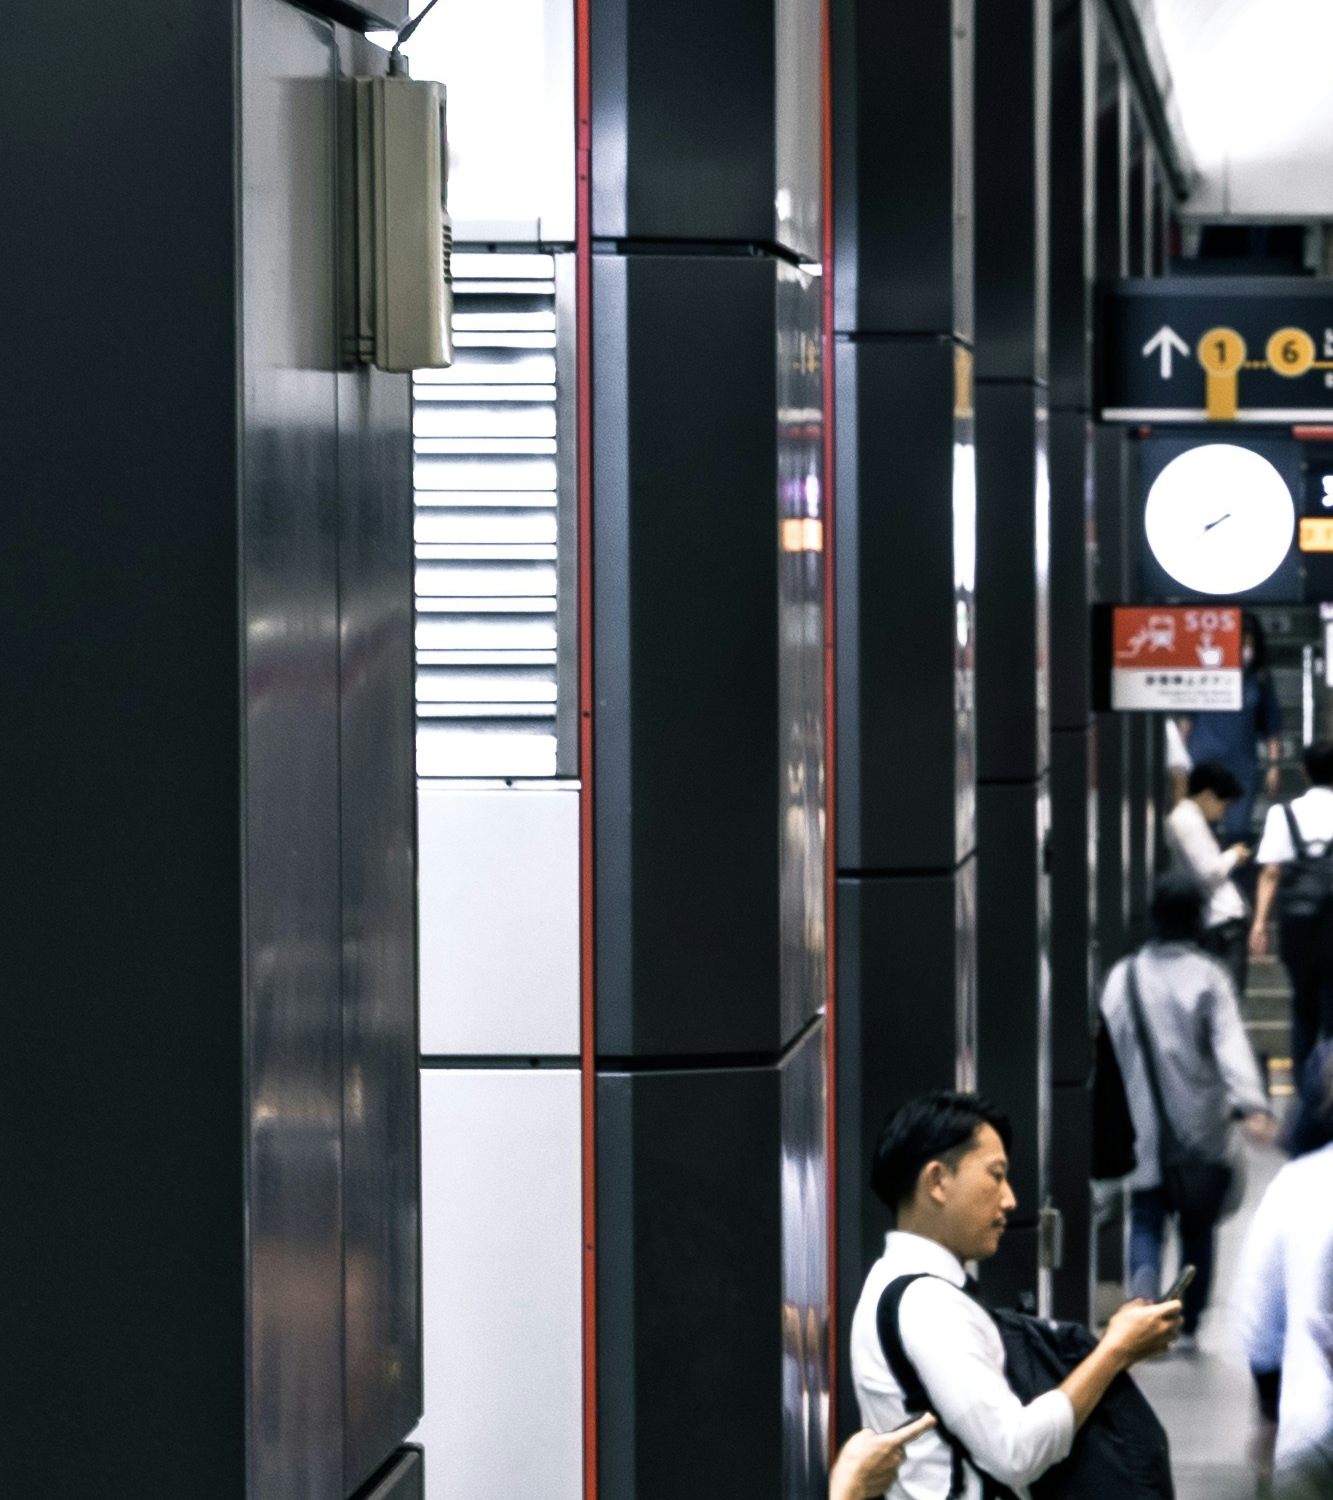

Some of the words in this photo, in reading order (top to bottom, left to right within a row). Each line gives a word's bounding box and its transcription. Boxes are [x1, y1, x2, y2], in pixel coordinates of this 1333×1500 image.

[1214, 340, 1227, 363] 1
[1281, 340, 1299, 364] 6
[1184, 610, 1236, 633] SOS
